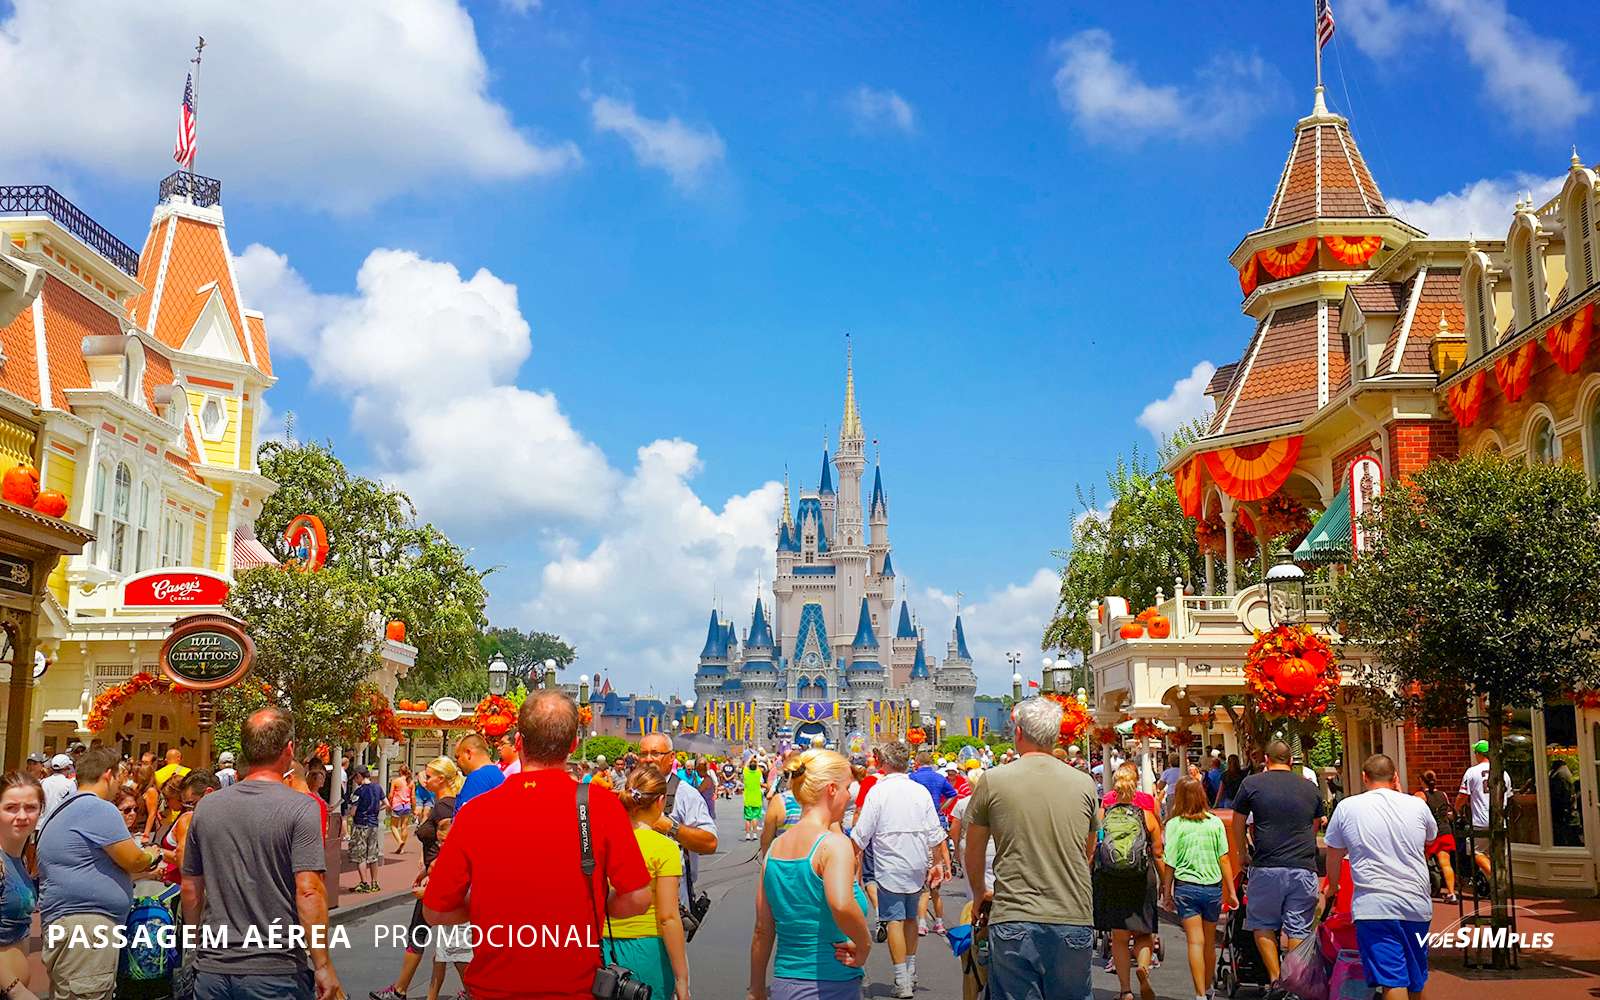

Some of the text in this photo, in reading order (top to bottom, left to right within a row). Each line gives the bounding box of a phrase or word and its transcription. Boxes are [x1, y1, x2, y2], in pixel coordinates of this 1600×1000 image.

[152, 576, 203, 599] Casey's
[191, 637, 221, 646] HALL
[171, 651, 239, 661] CHAMPIONS
[581, 822, 589, 853] DIGITAL
